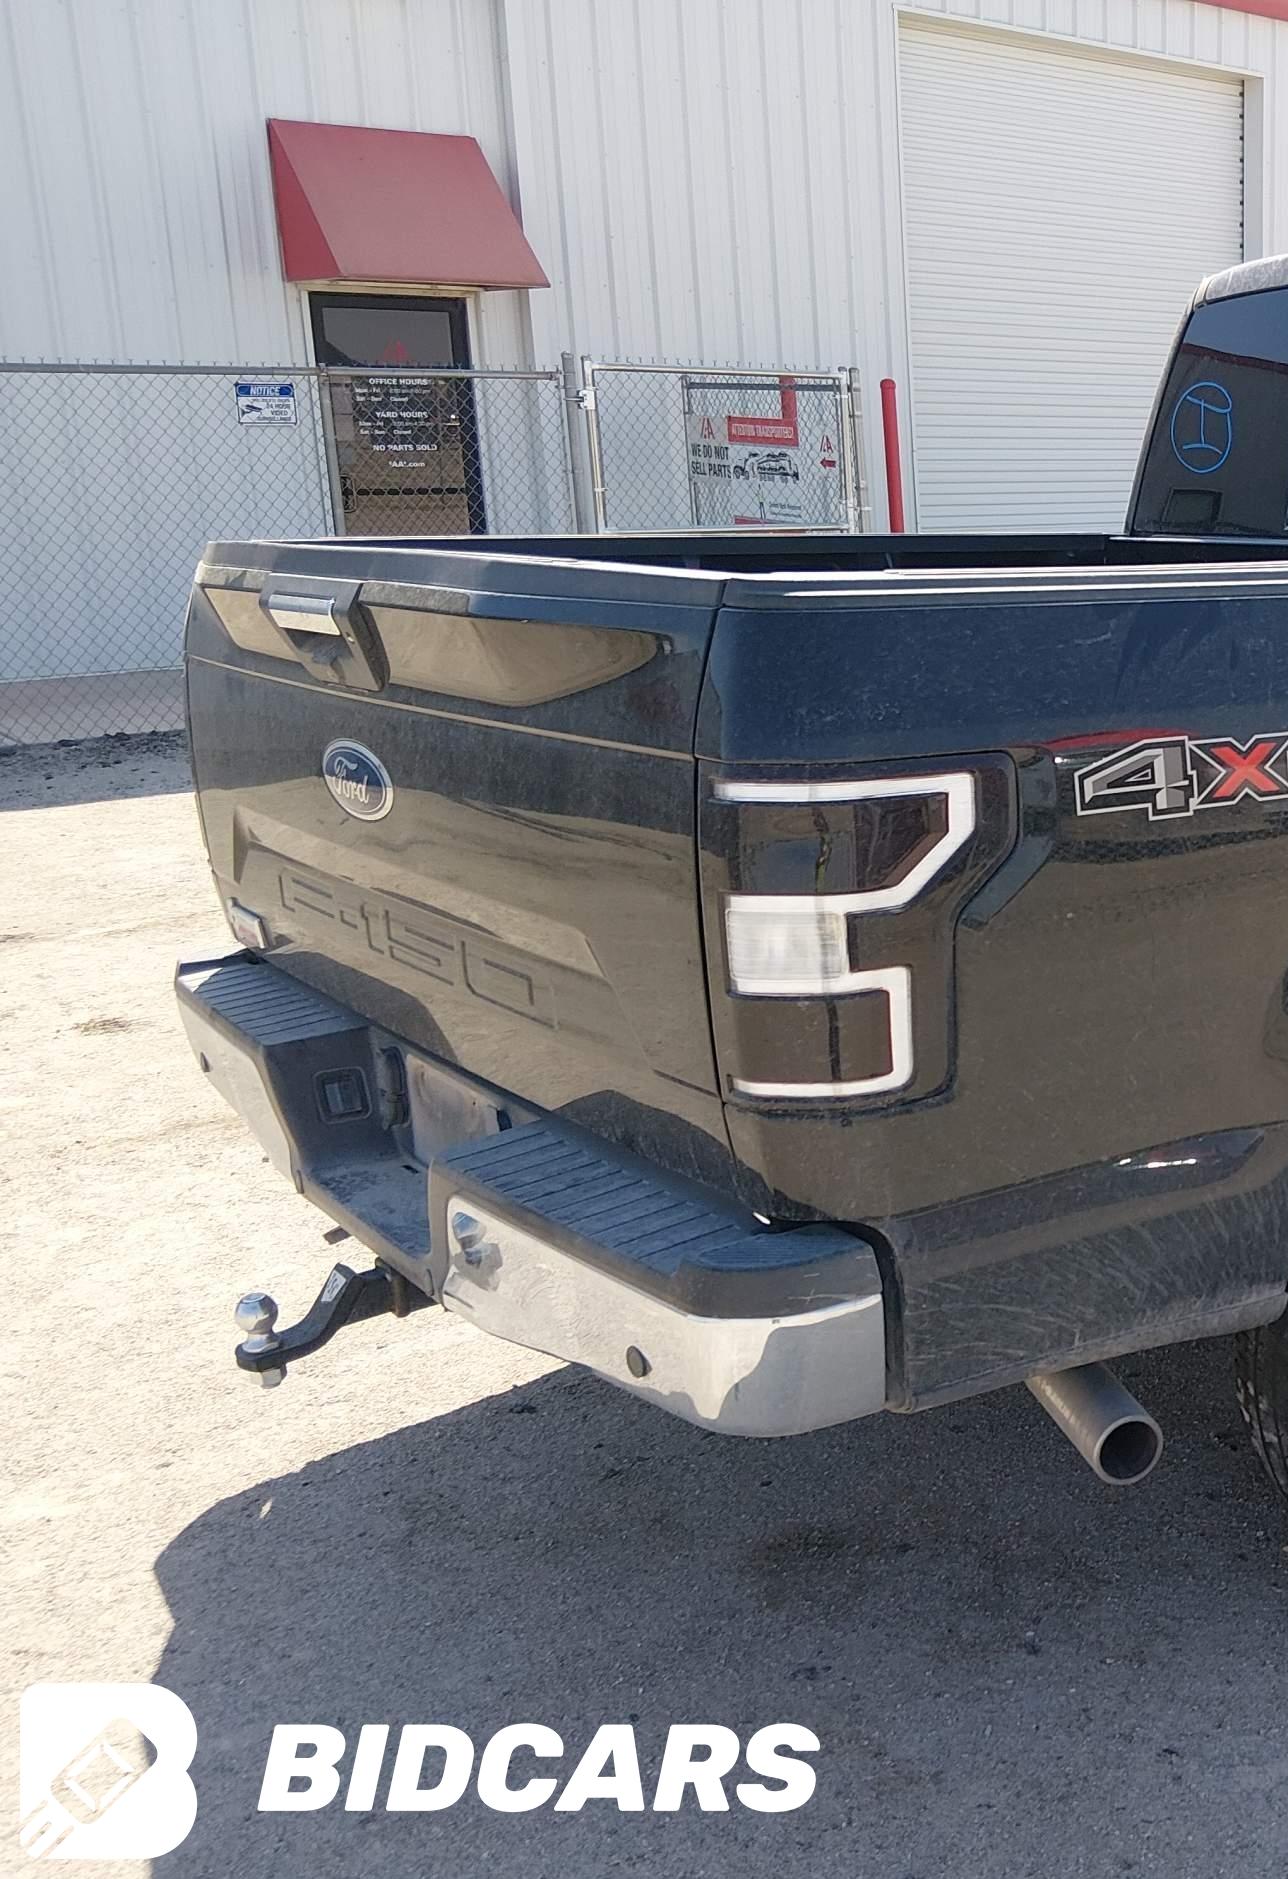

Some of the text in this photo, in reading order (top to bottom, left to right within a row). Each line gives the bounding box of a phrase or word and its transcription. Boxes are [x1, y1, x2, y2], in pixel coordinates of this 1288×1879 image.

[399, 378, 429, 386] HOURS
[250, 386, 281, 396] NOTICE
[375, 411, 429, 419] YARD HOURS
[372, 444, 438, 452] NO PARTS SOLD
[690, 443, 730, 461] WE DO NOT
[690, 460, 732, 479] SELL PARTS
[334, 756, 370, 804] Ford
[278, 868, 559, 1031] F-150
